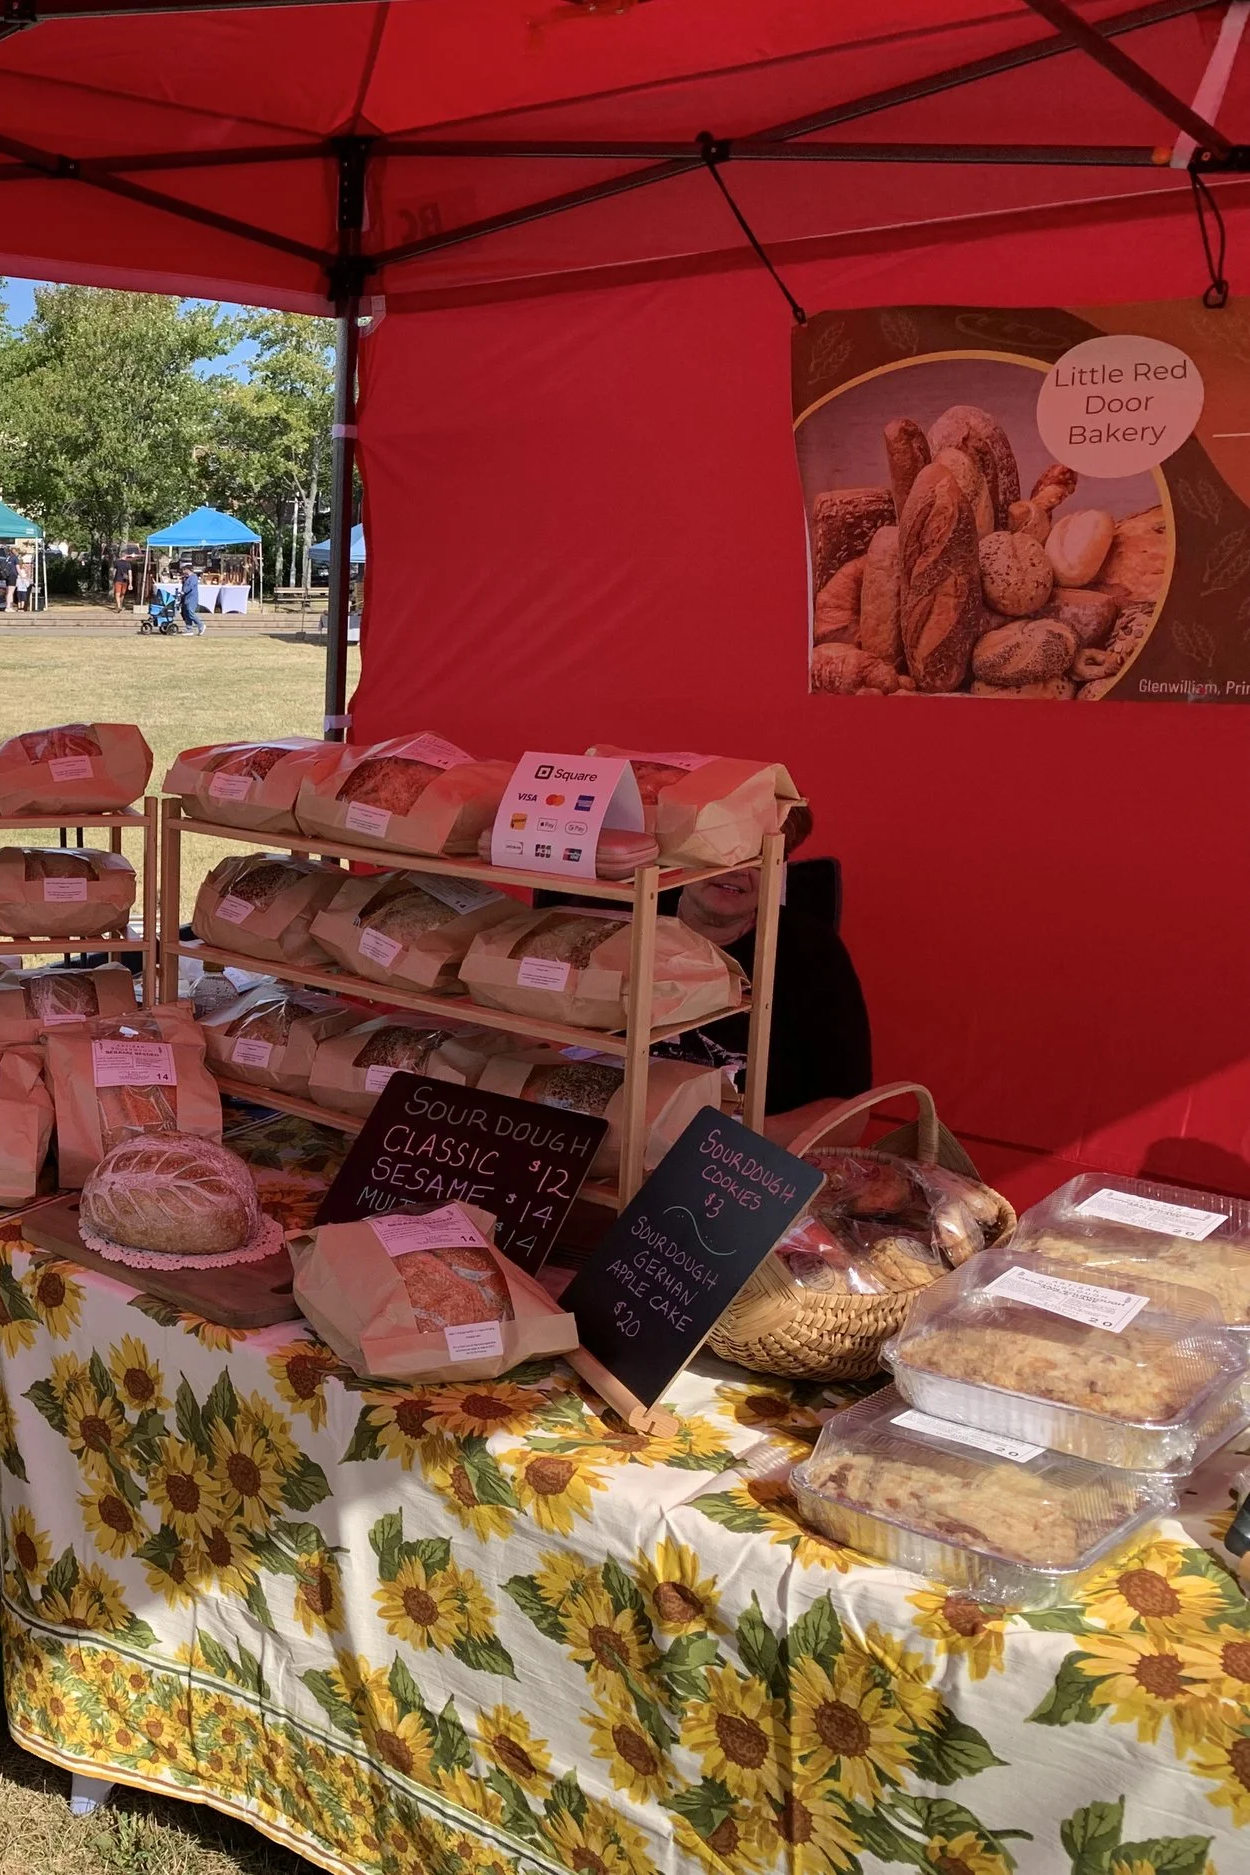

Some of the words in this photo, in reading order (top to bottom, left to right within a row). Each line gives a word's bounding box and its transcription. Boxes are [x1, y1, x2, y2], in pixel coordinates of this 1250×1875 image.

[1055, 364, 1124, 387] Little
[1134, 359, 1187, 382] Red
[1085, 395, 1154, 415] Door
[1068, 423, 1167, 446] Bakery
[1139, 678, 1221, 696] Glenwilliam,
[554, 768, 598, 782] Square
[517, 793, 538, 802] VISA
[404, 1086, 591, 1157] SOURDOUGH
[383, 1125, 499, 1175] CLASSIC
[529, 1160, 570, 1199] $12
[699, 1128, 797, 1204] SOURDOUGH
[371, 1156, 495, 1203] SESAME
[505, 1193, 552, 1228] $14
[701, 1164, 763, 1211] COOKIES
[704, 1192, 726, 1219] $3
[631, 1216, 719, 1291] SOURDOUGH
[633, 1250, 699, 1306] GERMAN
[606, 1260, 650, 1298] APPLE
[649, 1295, 693, 1332] CAKE
[613, 1301, 641, 1338] $20
[1088, 1317, 1113, 1327] 20
[994, 1446, 1019, 1457] 20
